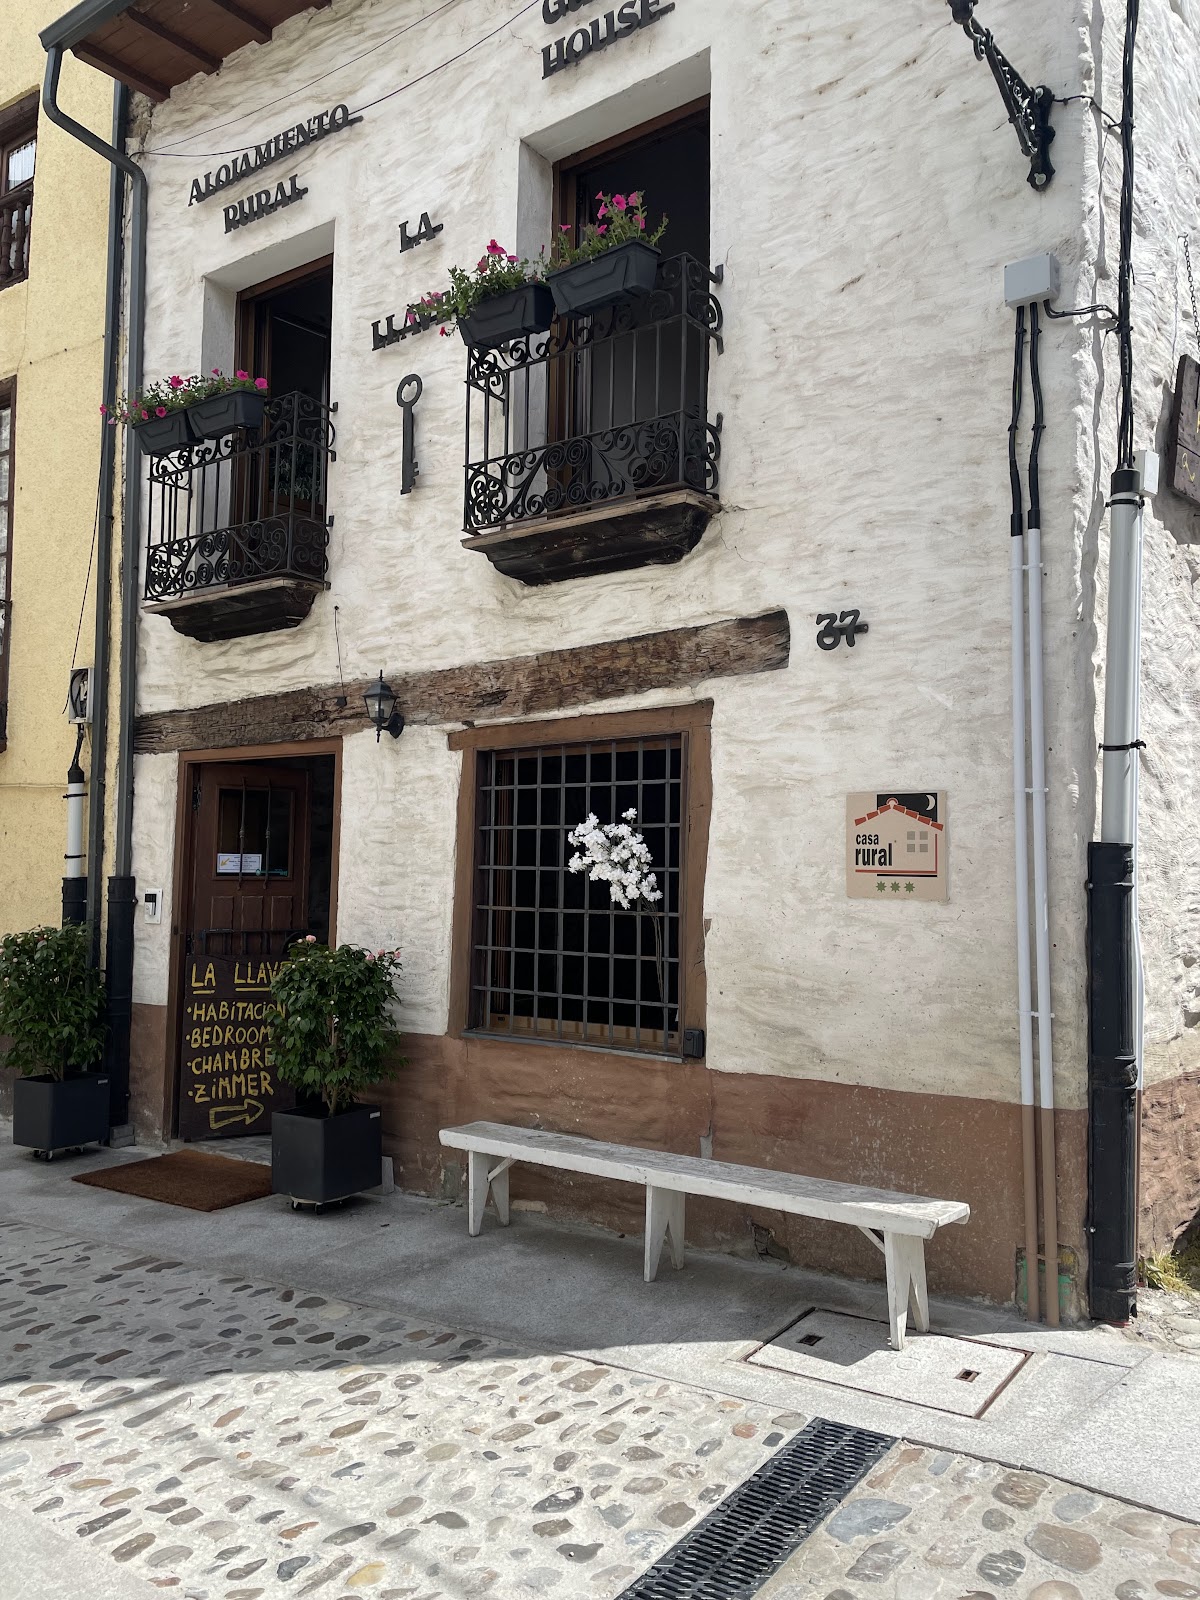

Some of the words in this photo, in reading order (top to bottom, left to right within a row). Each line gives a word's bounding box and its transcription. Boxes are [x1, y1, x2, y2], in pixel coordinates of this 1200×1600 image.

[541, 0, 661, 80] HOUSE
[223, 174, 304, 234] RURAL
[398, 212, 436, 253] LA
[816, 609, 861, 651] 37
[855, 843, 893, 867] rural
[856, 833, 879, 845] casa
[191, 962, 216, 987] LA
